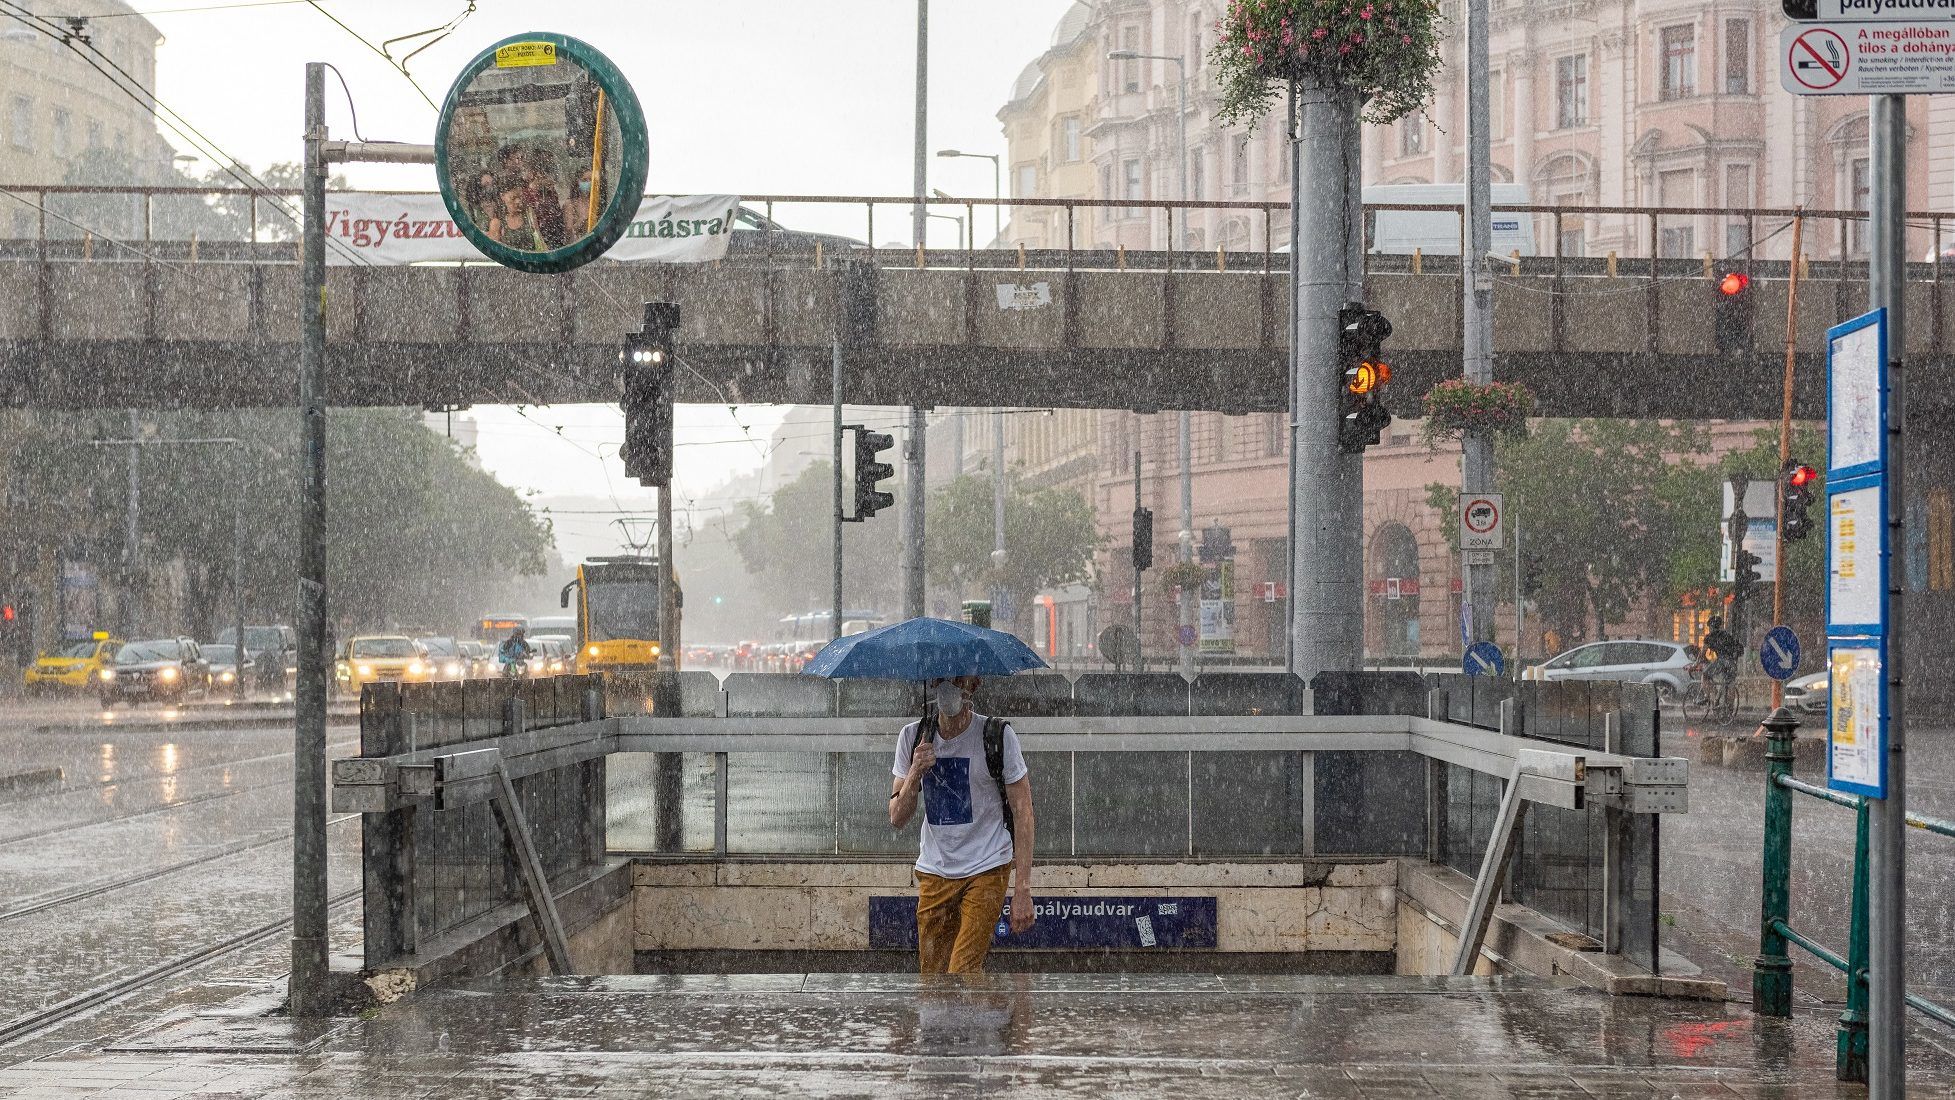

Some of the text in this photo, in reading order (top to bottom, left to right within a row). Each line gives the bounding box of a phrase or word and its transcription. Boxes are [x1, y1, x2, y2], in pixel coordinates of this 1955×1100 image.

[1858, 27, 1949, 41] A megállóban
[1859, 42, 1886, 53] tilos
[1891, 44, 1898, 53] a
[1870, 56, 1898, 64] smoking
[1034, 901, 1134, 919] pályaudvar
